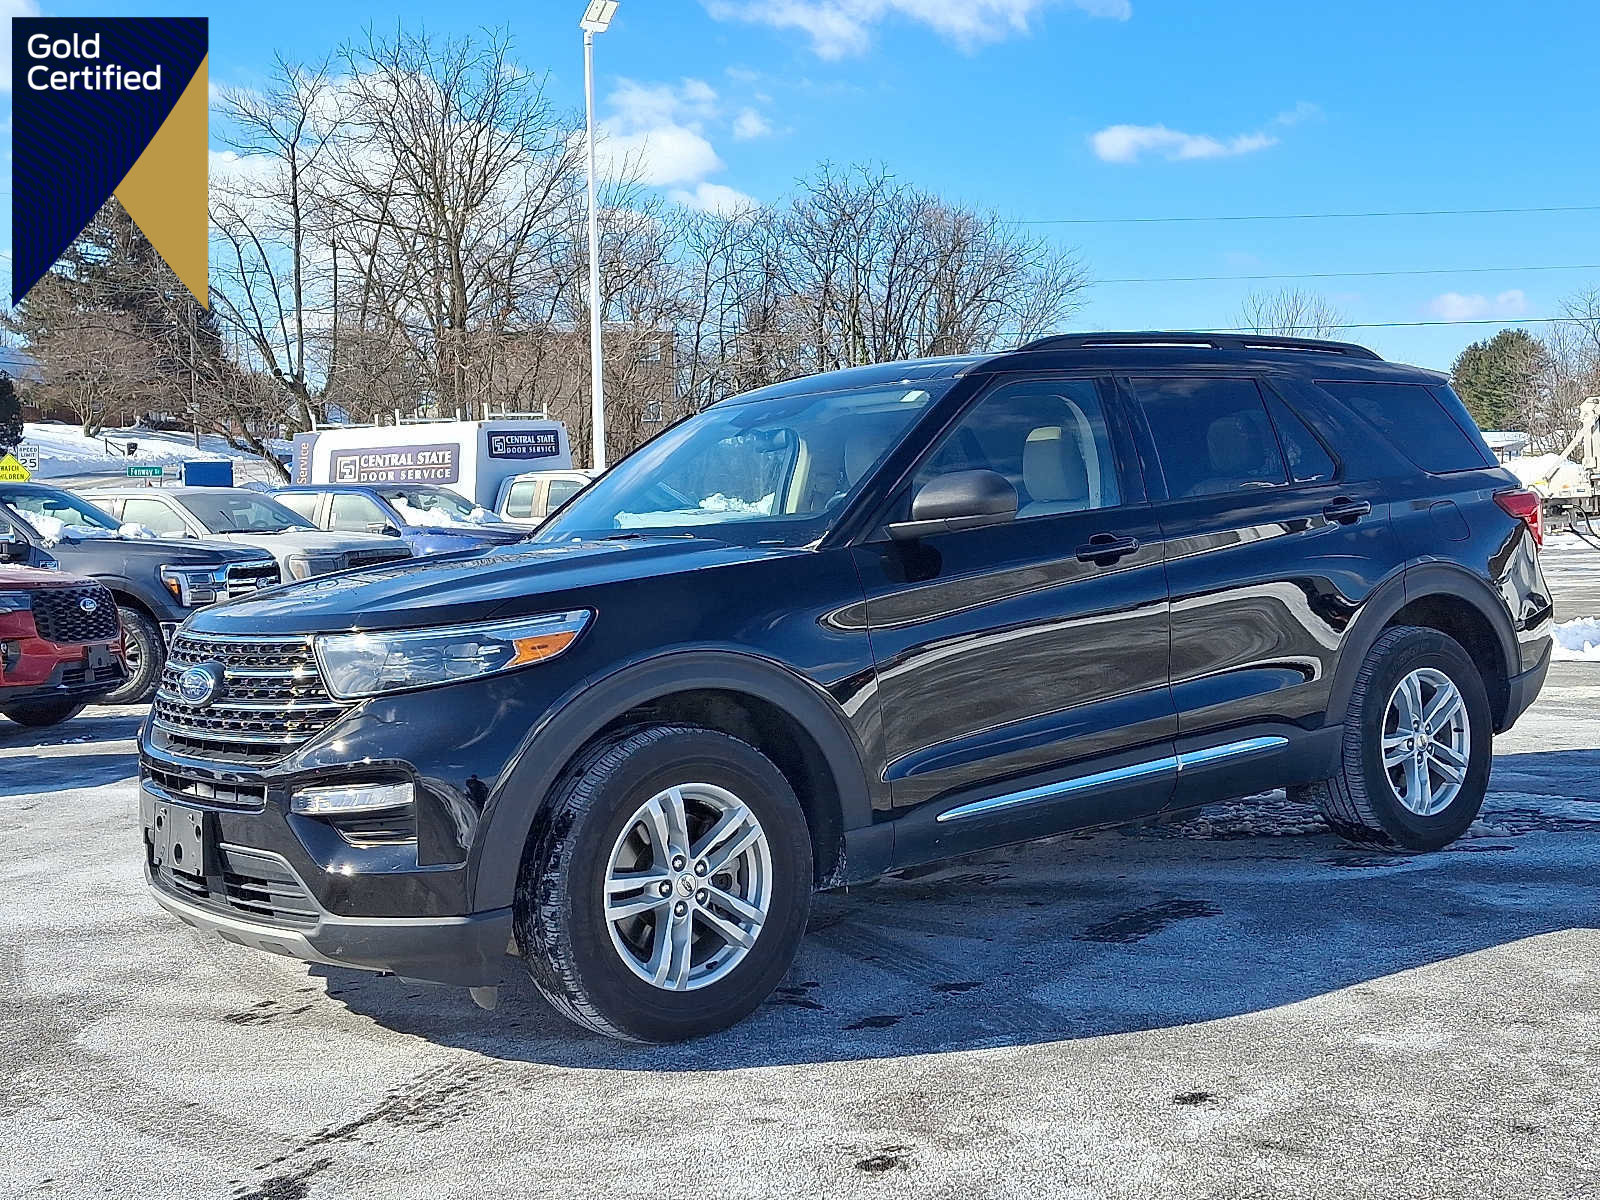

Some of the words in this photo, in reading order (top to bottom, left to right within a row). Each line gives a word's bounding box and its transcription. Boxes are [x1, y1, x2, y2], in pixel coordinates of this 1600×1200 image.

[505, 435, 535, 444] CENTRAL
[536, 434, 555, 443] STATE
[506, 446, 527, 454] DOOR
[528, 445, 556, 453] SERVICE
[19, 458, 37, 468] 25
[297, 442, 309, 484] Service
[360, 453, 414, 467] CENTRAL
[416, 451, 452, 465] STATE
[360, 471, 395, 482] DOOR
[400, 469, 452, 480] SERVICE
